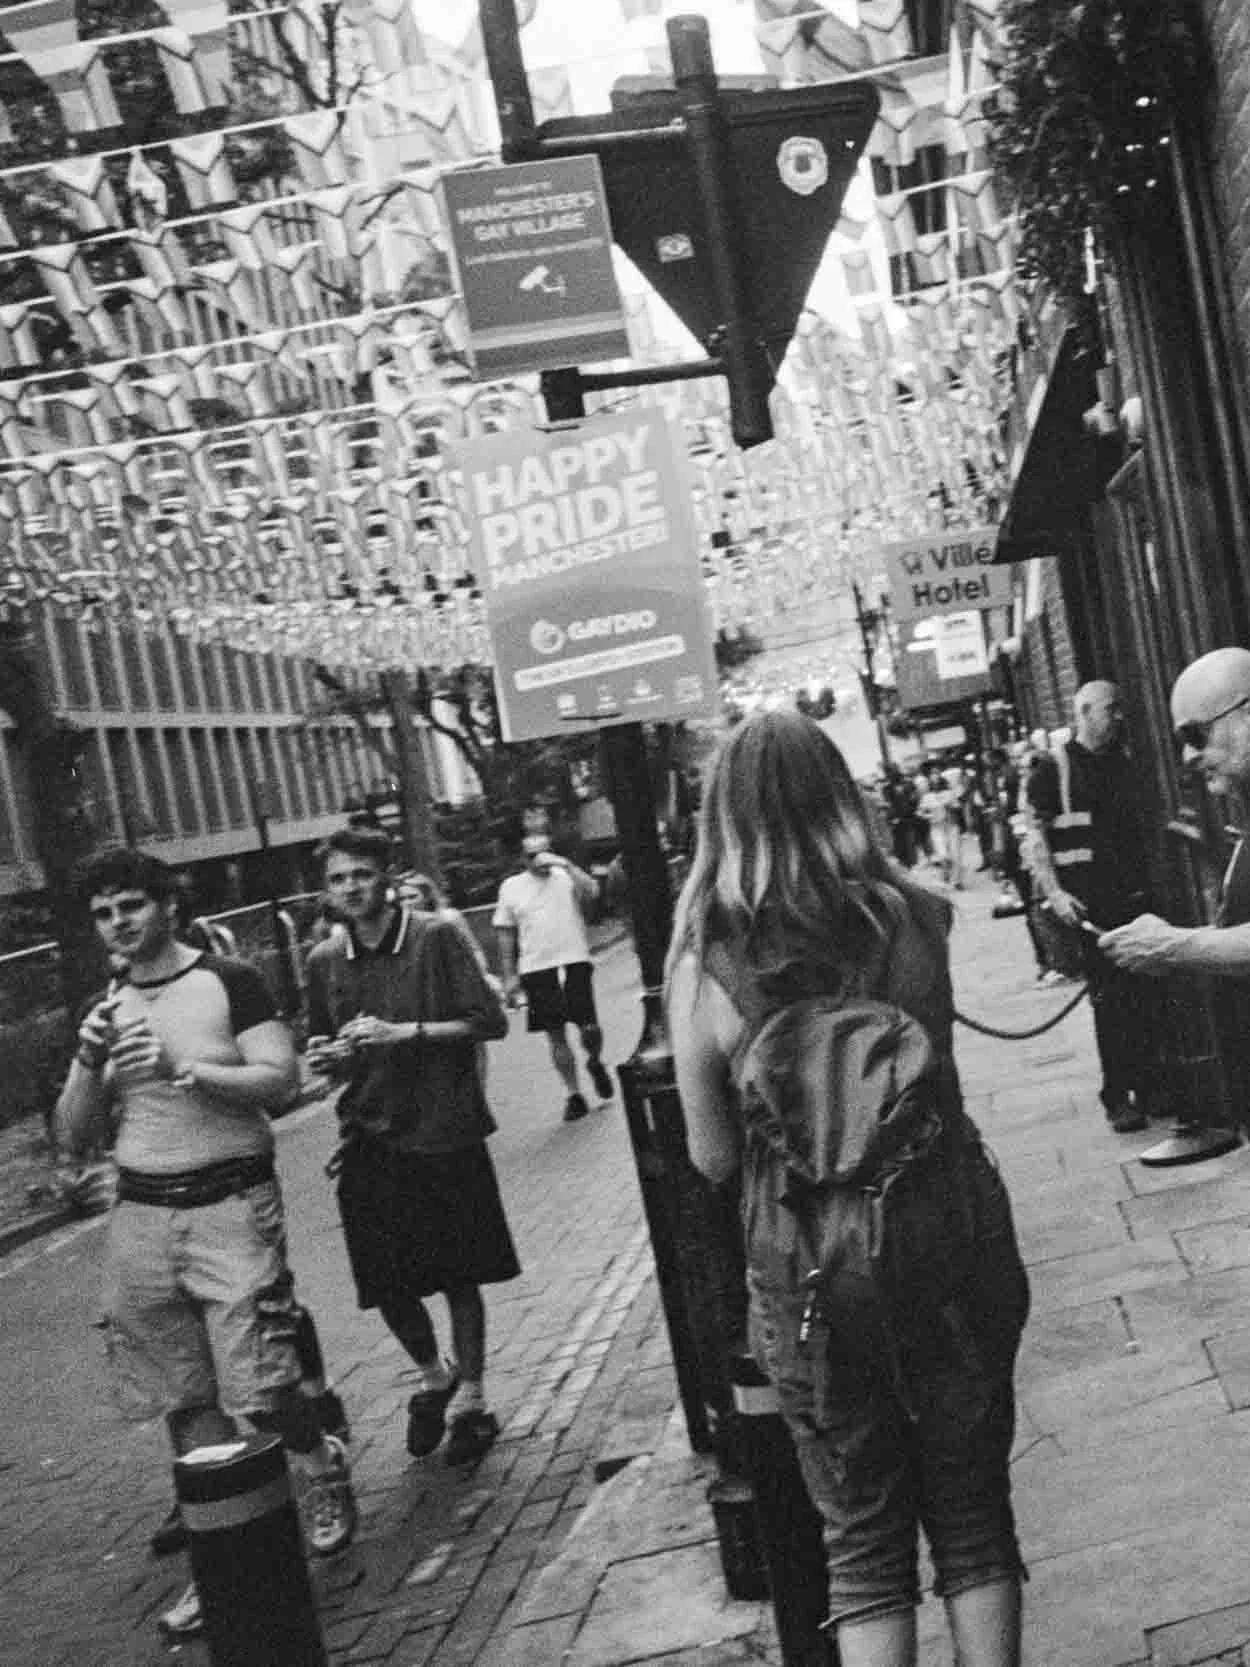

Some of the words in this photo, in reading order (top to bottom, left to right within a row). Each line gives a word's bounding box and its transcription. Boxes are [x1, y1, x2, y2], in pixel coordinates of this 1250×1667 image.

[472, 424, 648, 516] HAPPY
[482, 469, 666, 567] PRIDE
[911, 572, 990, 607] Hotel
